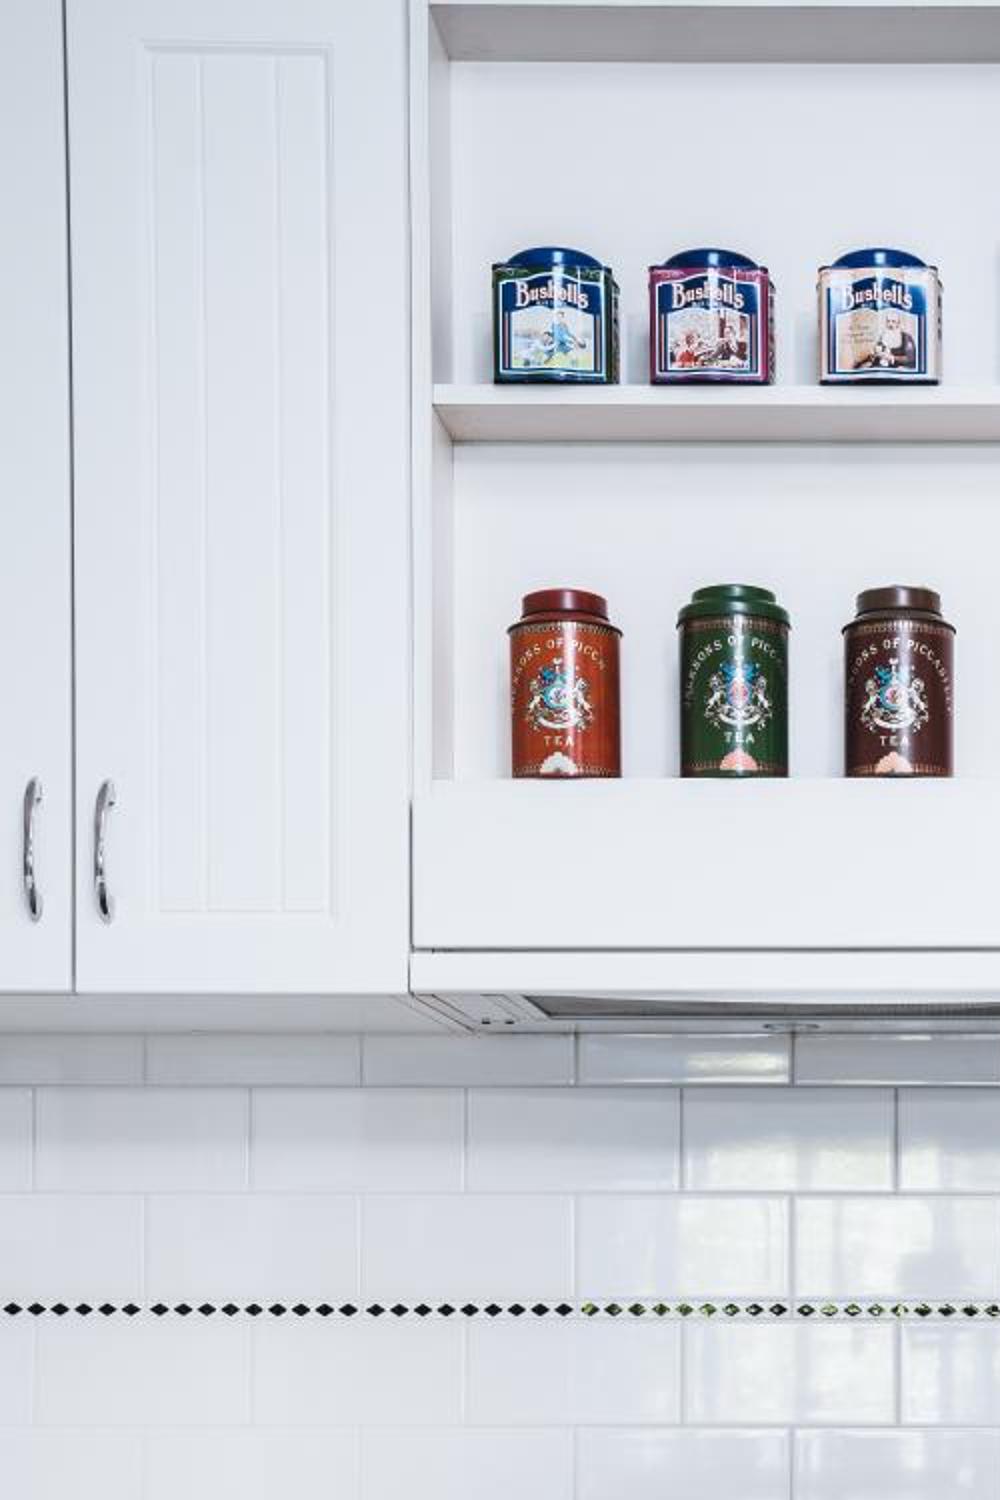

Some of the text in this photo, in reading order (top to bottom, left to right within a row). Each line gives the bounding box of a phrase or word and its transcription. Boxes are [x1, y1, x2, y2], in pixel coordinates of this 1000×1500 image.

[515, 279, 589, 309] Bushells
[671, 281, 745, 309] Bushells
[842, 281, 913, 310] Bushells
[543, 735, 575, 747] TEA
[724, 731, 755, 744] TEA
[880, 735, 910, 747] TEA
